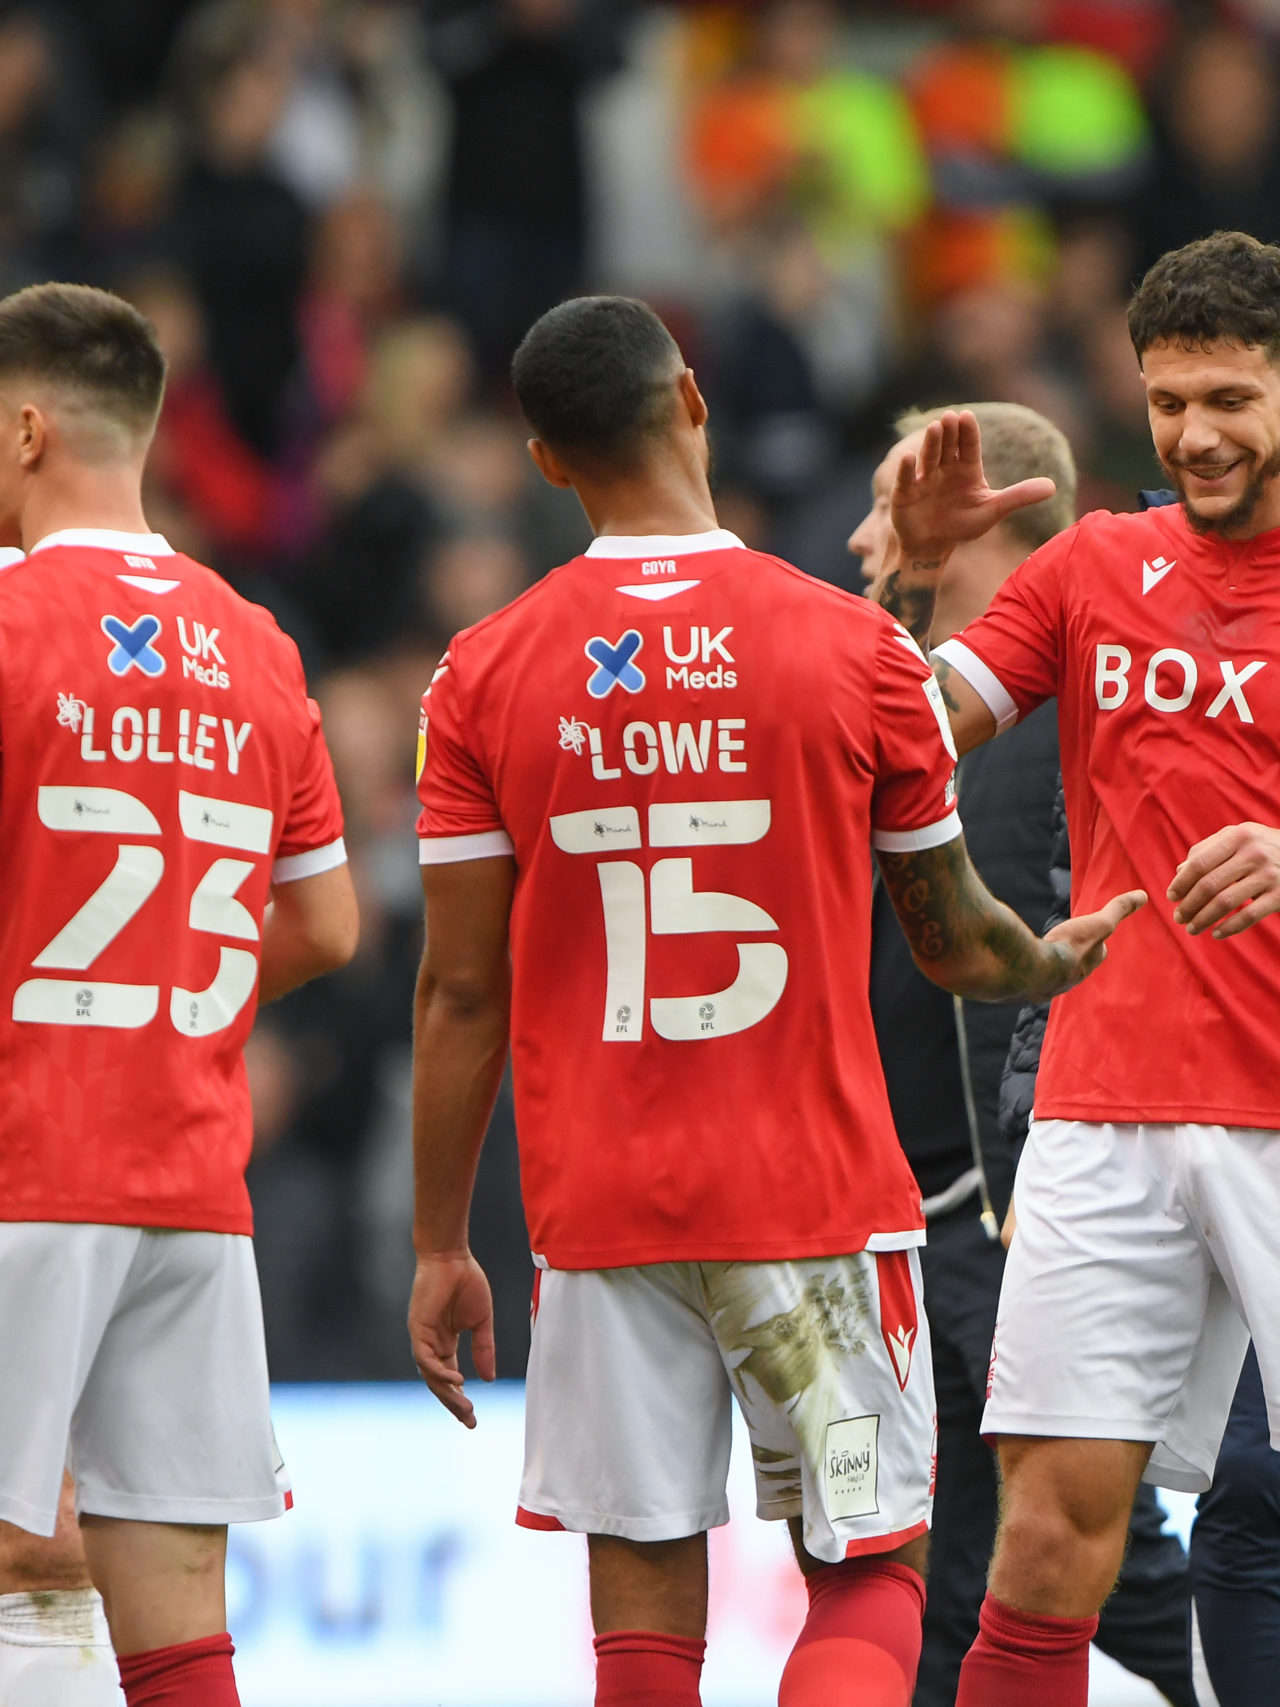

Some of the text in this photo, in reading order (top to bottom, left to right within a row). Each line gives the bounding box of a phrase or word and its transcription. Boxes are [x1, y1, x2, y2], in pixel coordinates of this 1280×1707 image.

[176, 615, 226, 665] UK
[663, 626, 735, 664] UK
[181, 655, 231, 689] Meds
[665, 664, 737, 690] Meds
[81, 706, 252, 775] LOLLEY
[590, 718, 748, 781] LOWE
[12, 786, 273, 1038] 23
[549, 800, 789, 1042] 15
[615, 1024, 628, 1033] EFL
[700, 1022, 714, 1031] EFL
